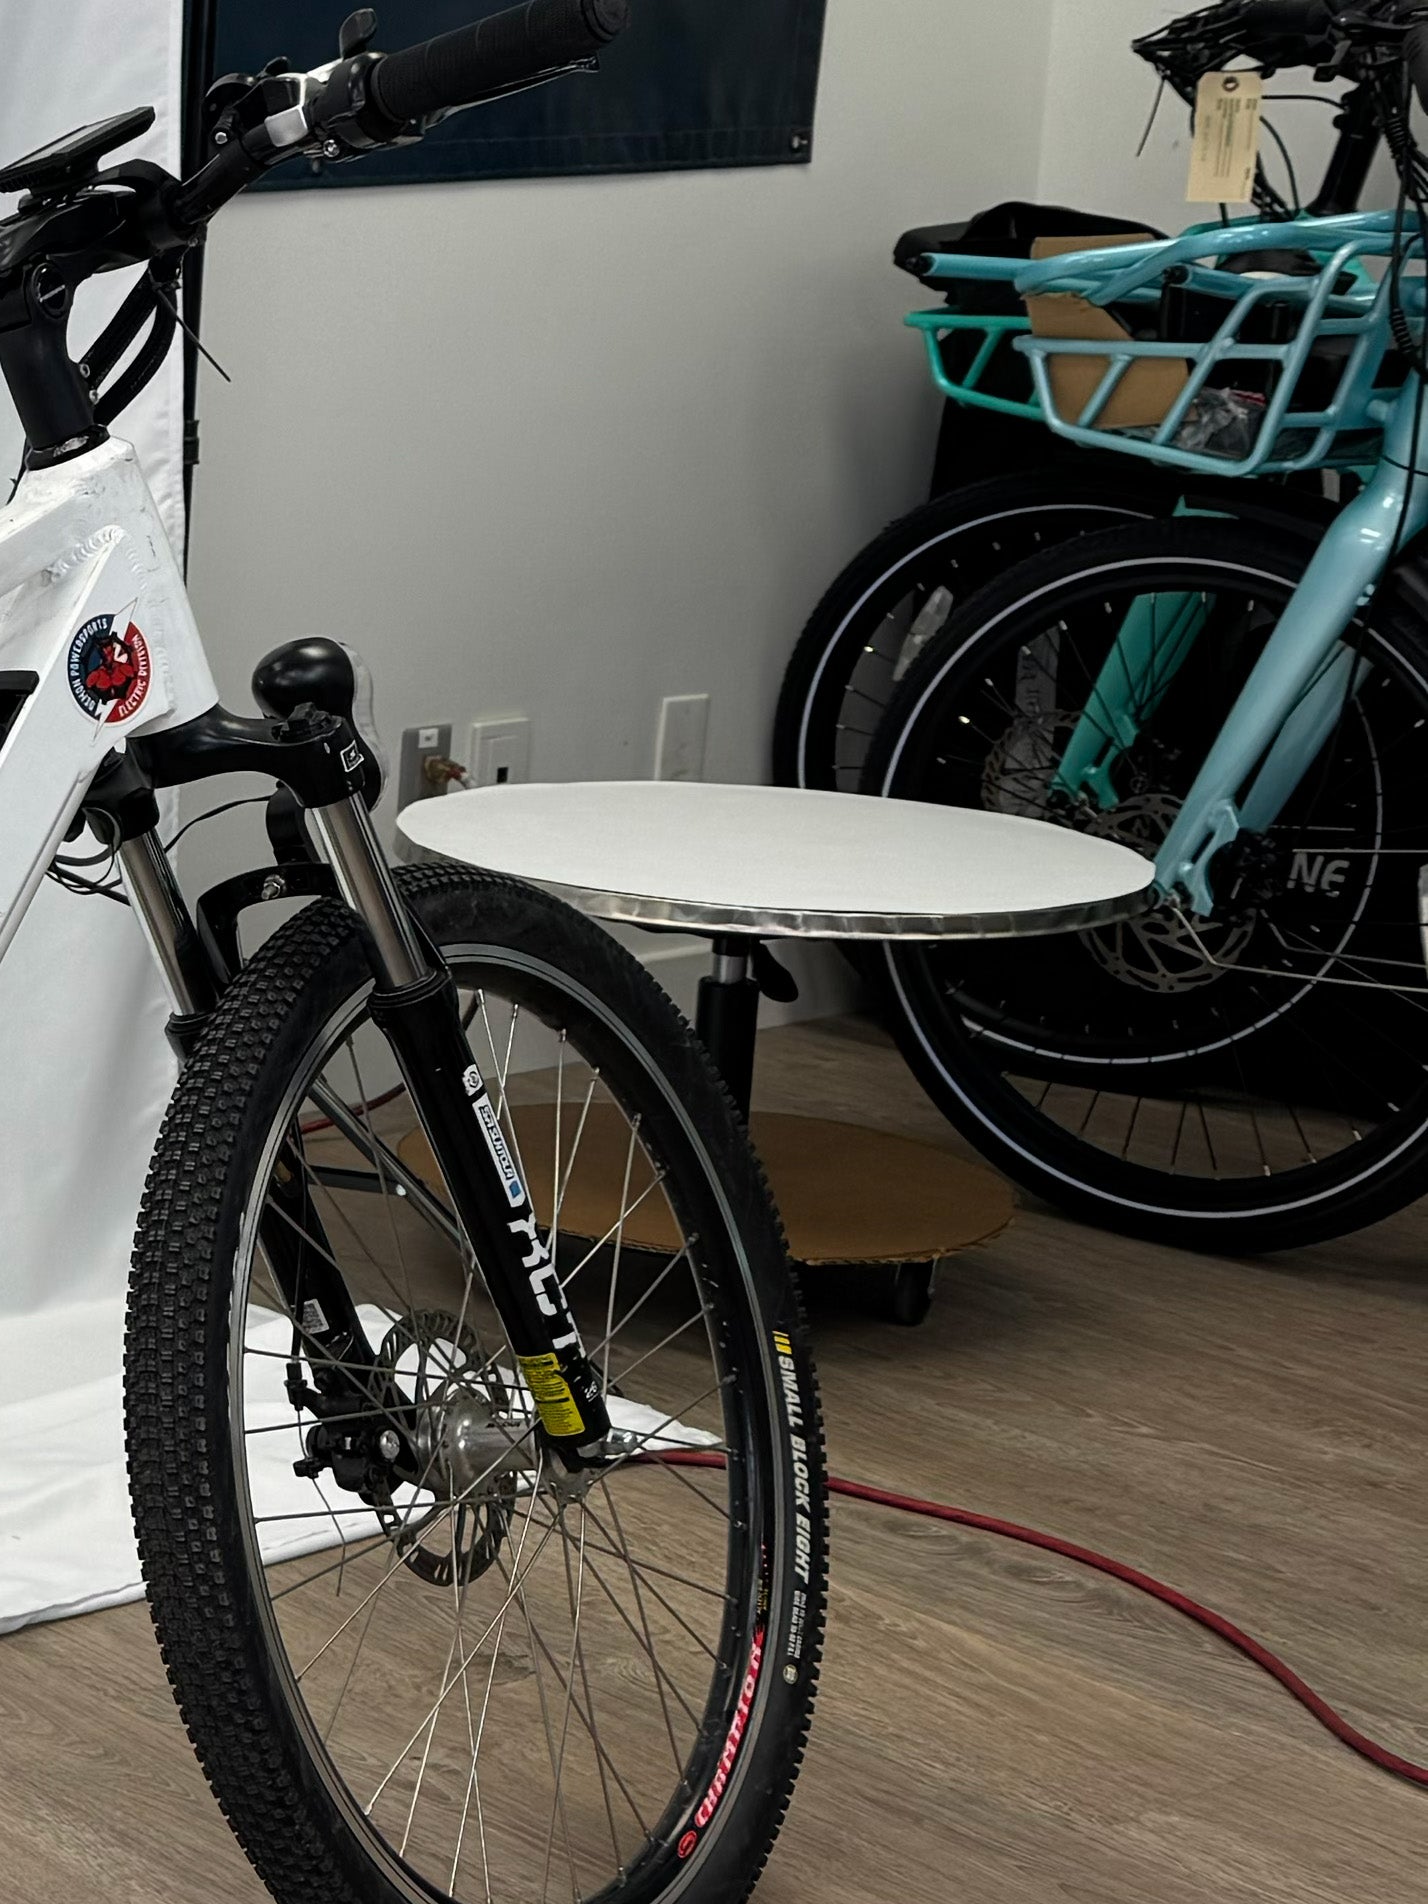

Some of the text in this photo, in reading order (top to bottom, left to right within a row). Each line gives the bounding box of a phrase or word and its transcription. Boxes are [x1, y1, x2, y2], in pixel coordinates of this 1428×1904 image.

[69, 618, 108, 711] DEMON POWERSPORTS
[117, 680, 146, 717] ELECTRIC
[506, 1211, 587, 1359] XCT
[777, 1355, 804, 1427] SMALL
[790, 1432, 811, 1514] BLOCK
[795, 1511, 811, 1585] EIGHT
